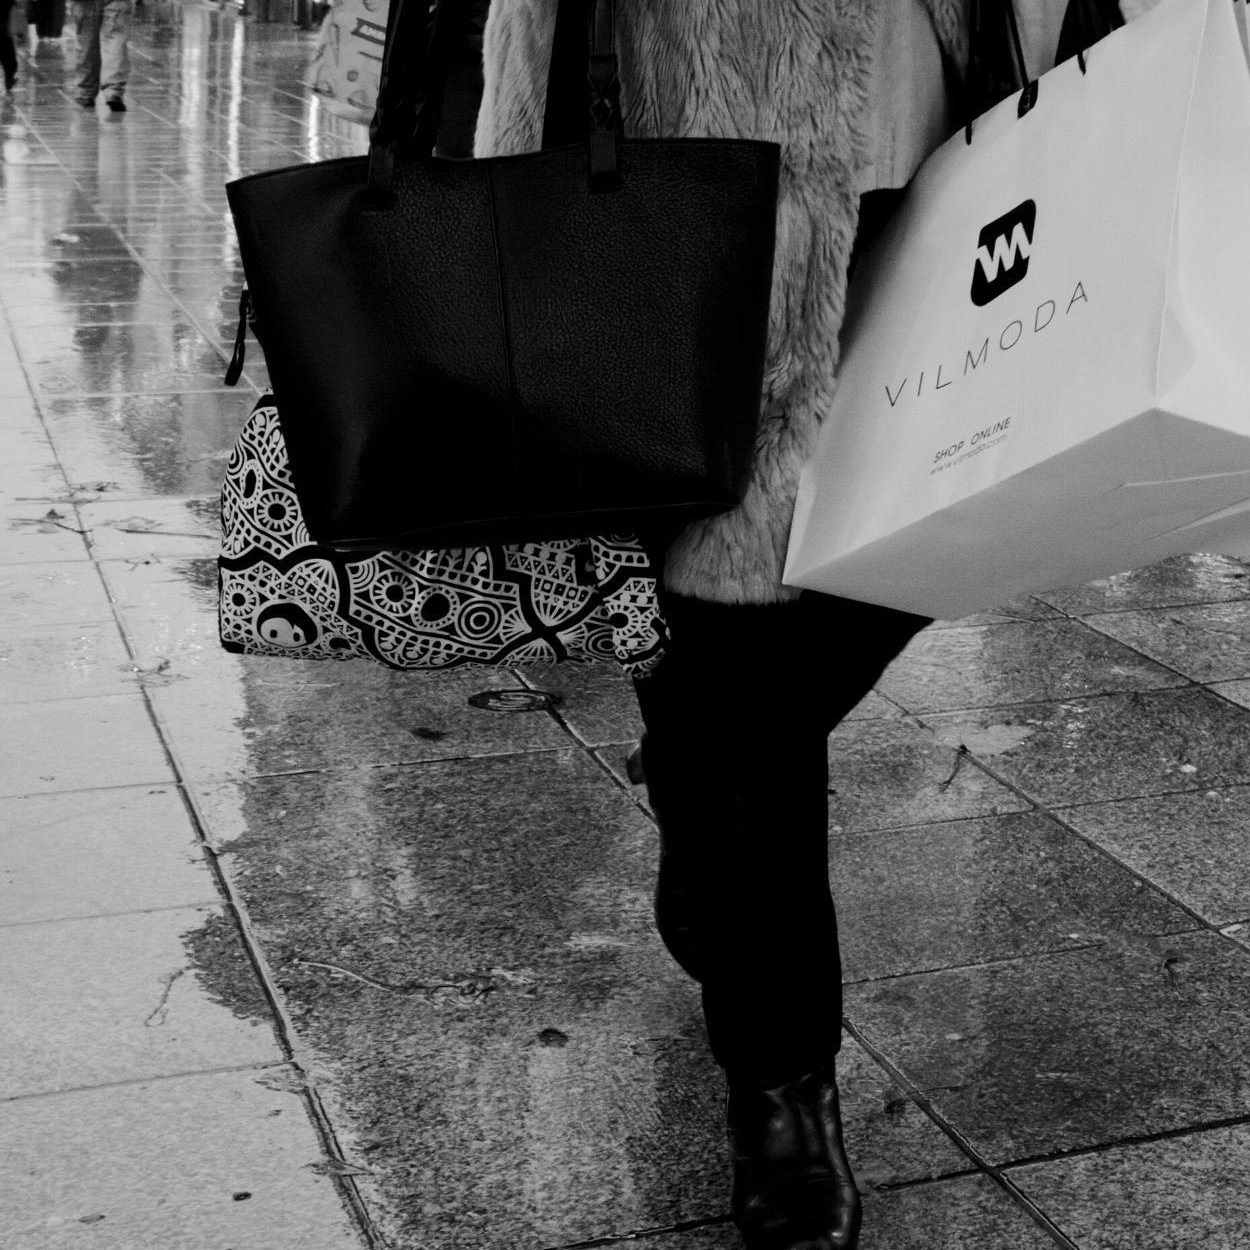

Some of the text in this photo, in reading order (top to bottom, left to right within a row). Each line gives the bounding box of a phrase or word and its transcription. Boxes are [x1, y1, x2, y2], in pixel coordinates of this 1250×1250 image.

[885, 281, 1088, 407] VILMODA
[933, 415, 1011, 463] SHOP ONLINE
